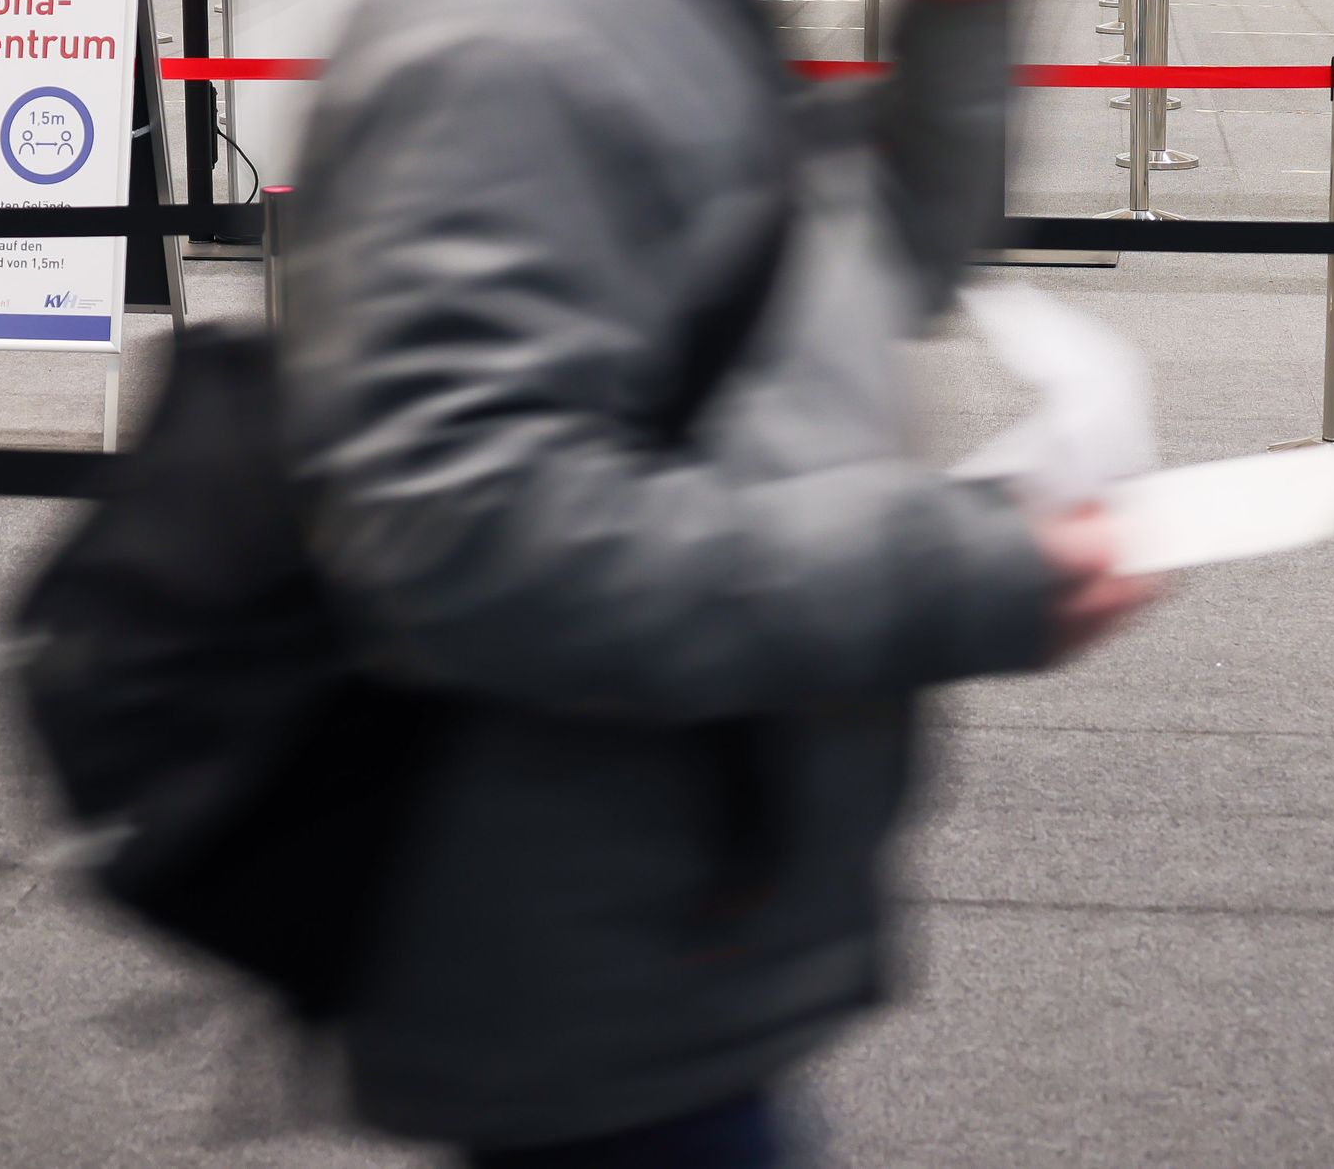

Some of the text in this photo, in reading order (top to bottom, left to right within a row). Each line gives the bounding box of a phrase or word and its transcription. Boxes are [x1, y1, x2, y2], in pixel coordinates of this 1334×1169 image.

[29, 111, 65, 126] 1,5m
[20, 240, 42, 251] den
[7, 260, 28, 269] von
[32, 258, 64, 270] 1,5m!
